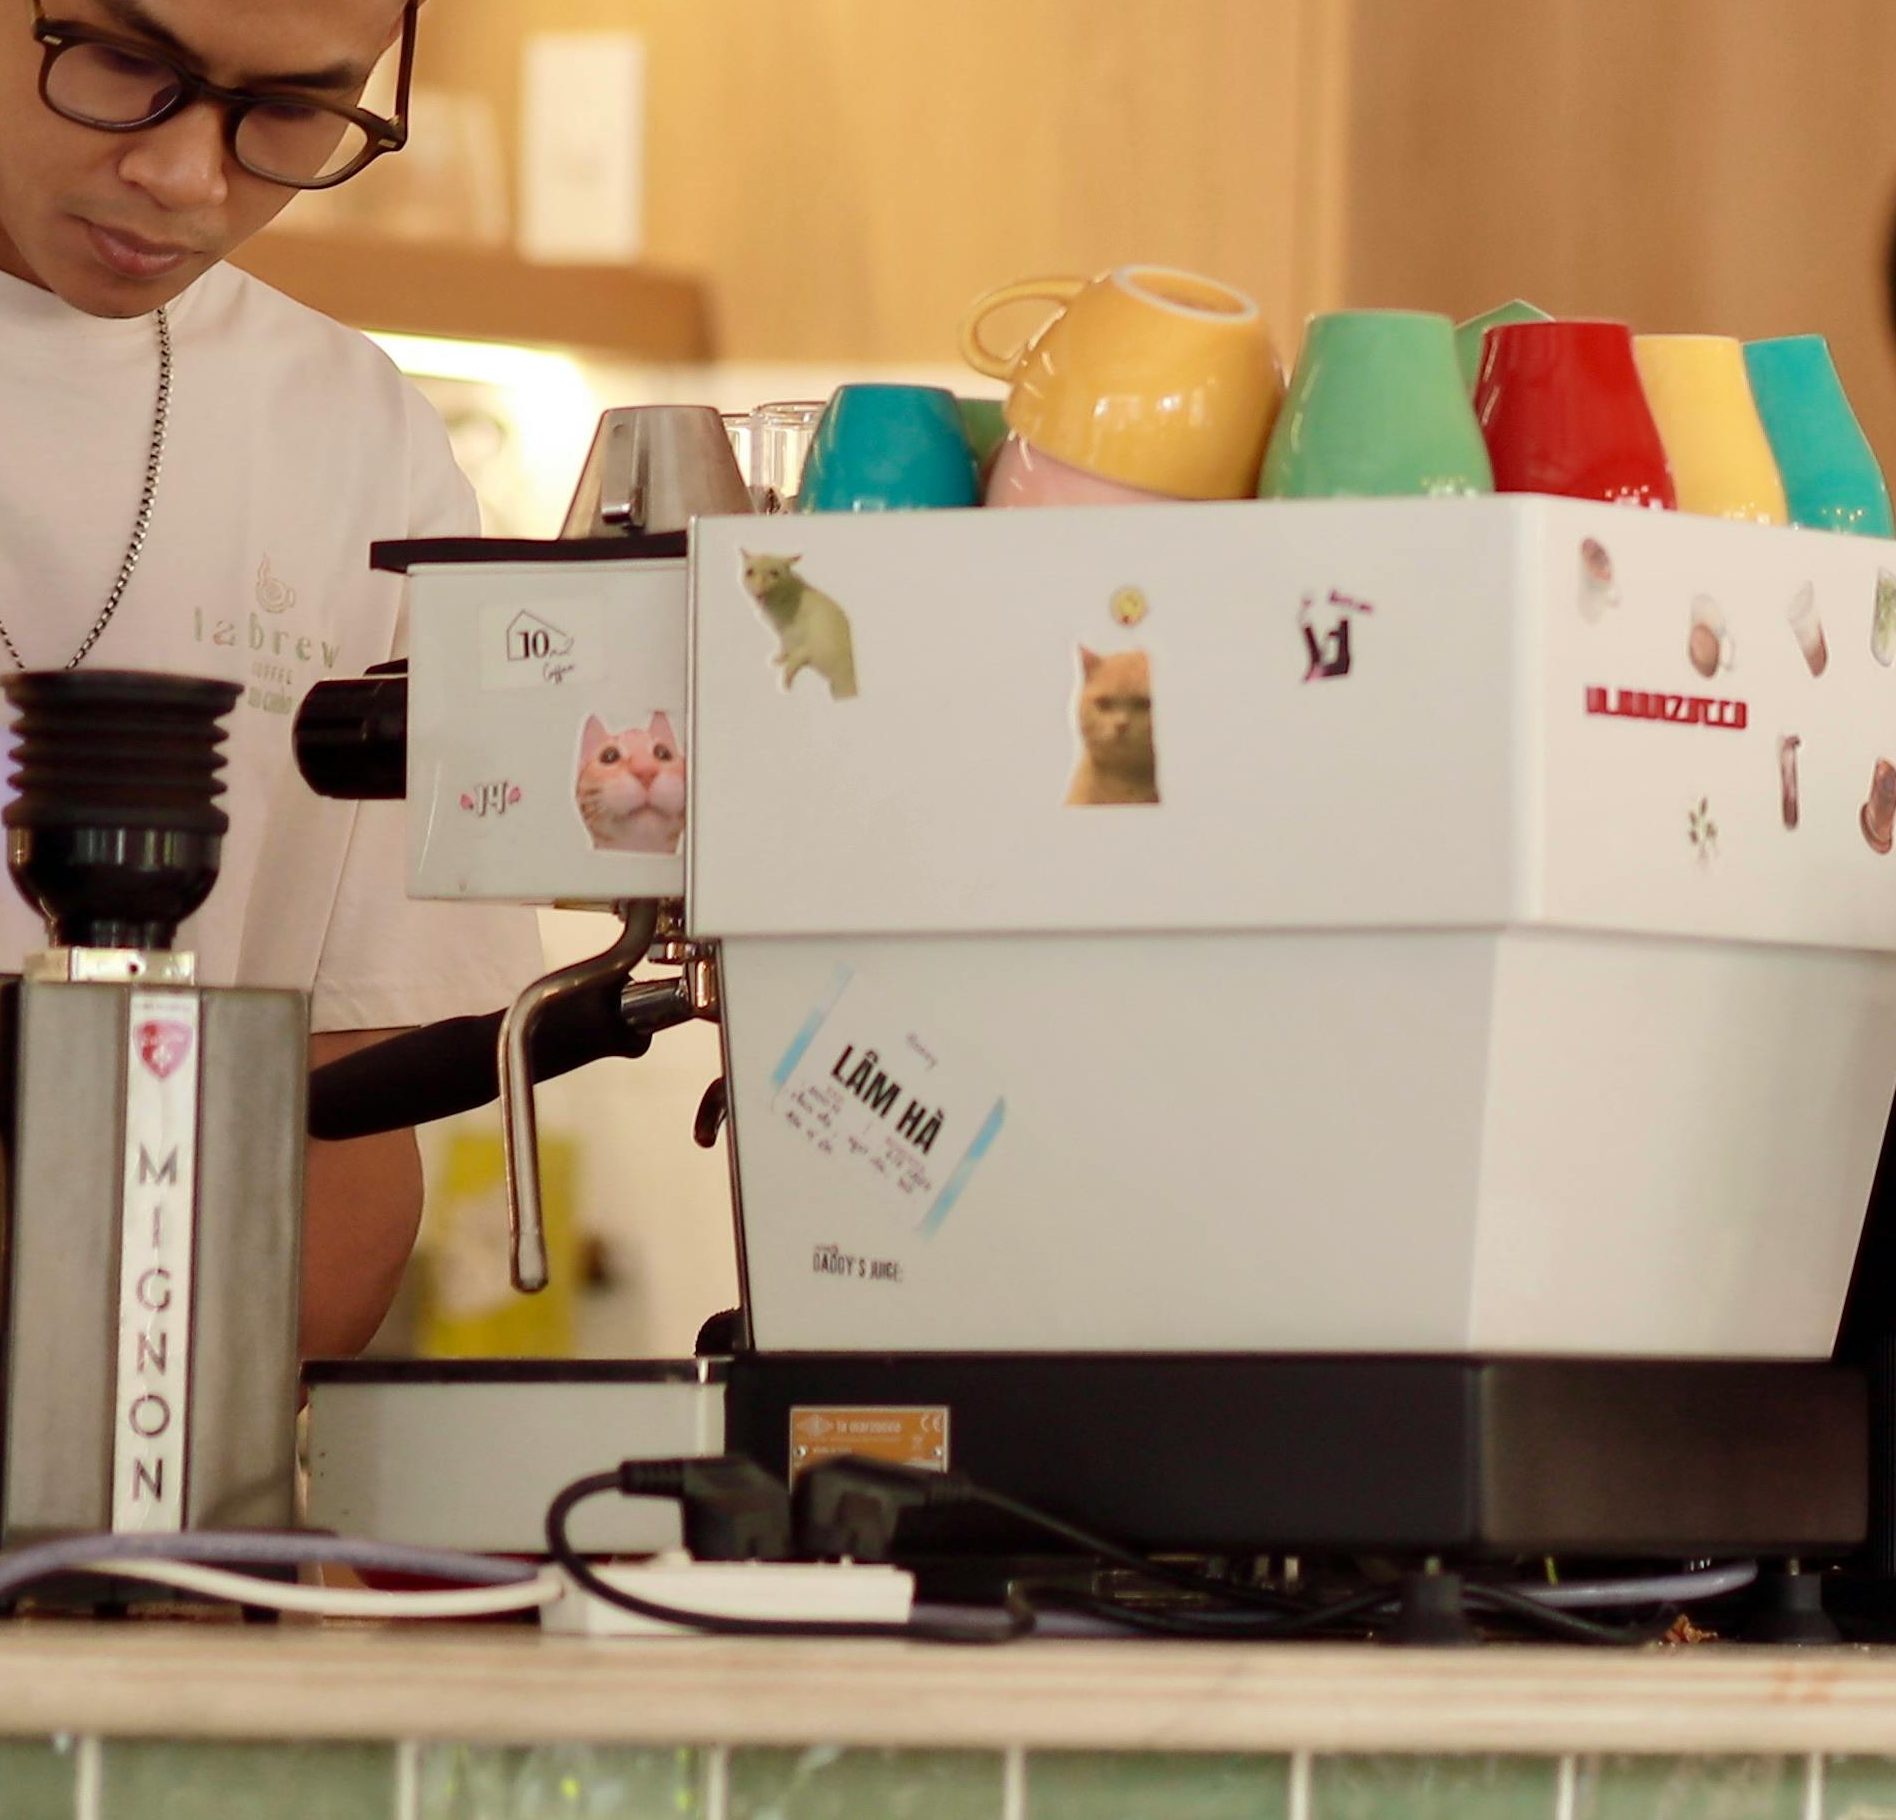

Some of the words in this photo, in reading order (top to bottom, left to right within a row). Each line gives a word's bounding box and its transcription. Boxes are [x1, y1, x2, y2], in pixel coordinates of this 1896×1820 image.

[195, 606, 341, 669] labrew
[830, 1043, 902, 1119] LÂM
[896, 1097, 945, 1157] HÀ
[128, 1143, 179, 1504] MIGNON
